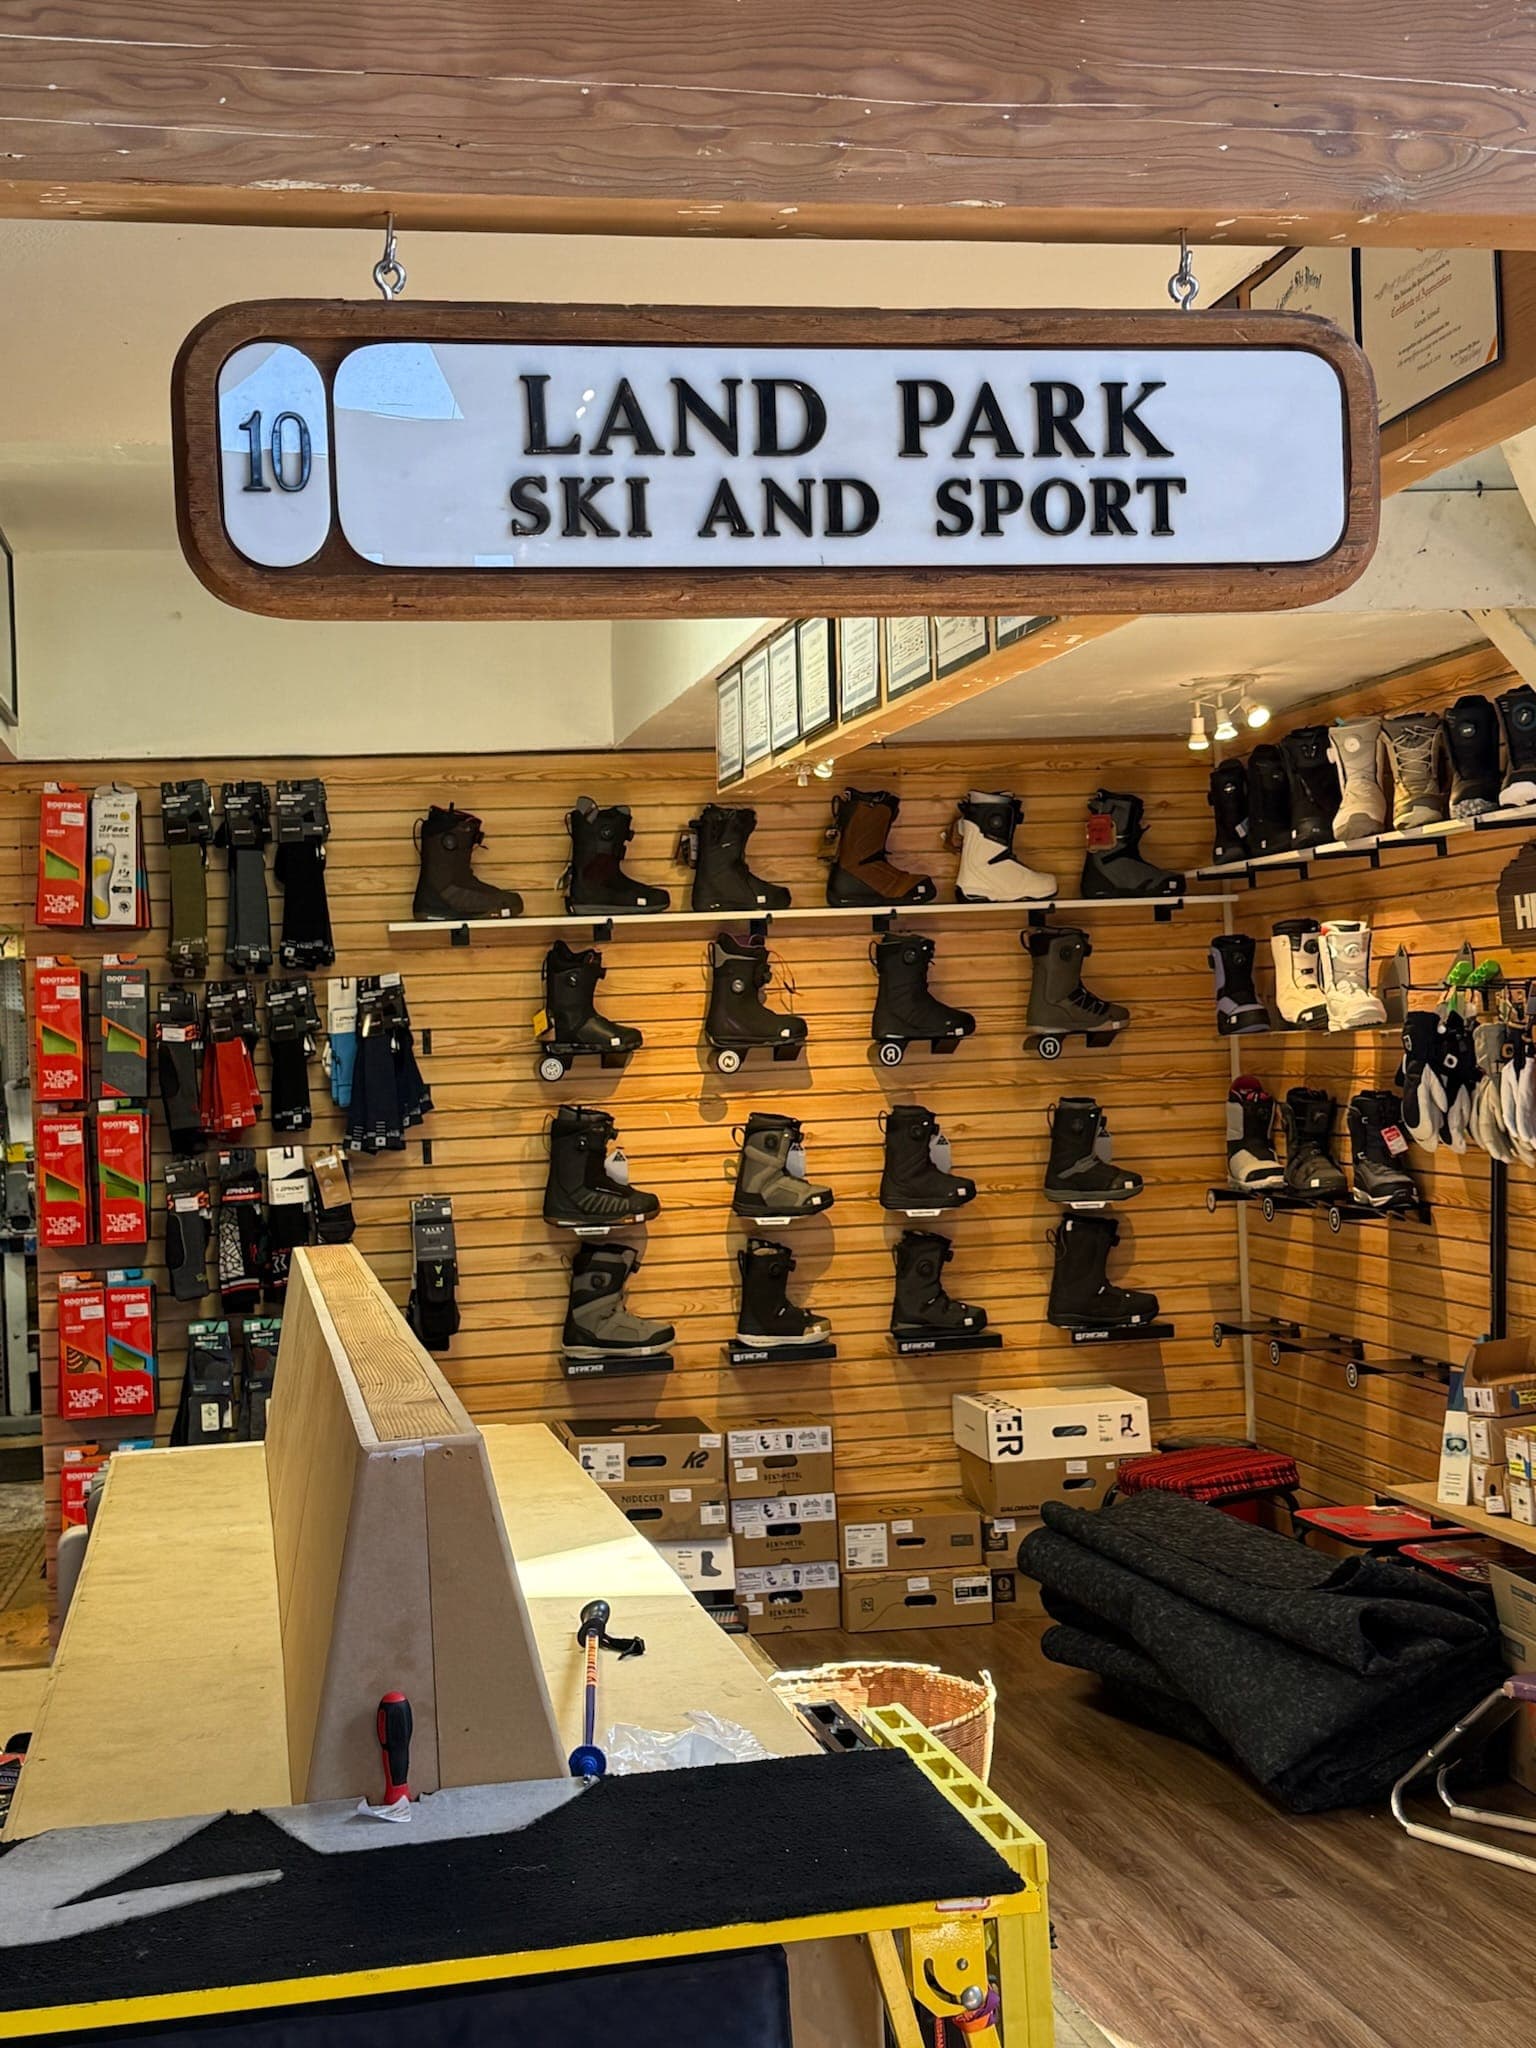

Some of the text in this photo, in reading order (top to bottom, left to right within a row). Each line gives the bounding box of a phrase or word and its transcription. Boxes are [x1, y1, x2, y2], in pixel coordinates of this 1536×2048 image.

[519, 374, 1175, 458] LAND PARK
[238, 410, 312, 493] 10
[510, 475, 1187, 538] SKI AND SPORT
[44, 894, 75, 904] TUNE
[44, 906, 74, 914] FEET
[43, 1069, 74, 1079] TUNE
[43, 1081, 72, 1089] FEET
[46, 1216, 77, 1225] TUNE
[106, 1213, 137, 1222] TUNE
[46, 1228, 75, 1236] FEET
[107, 1225, 135, 1233] FEET
[68, 1388, 99, 1397] TUNE
[114, 1384, 145, 1394] TUNE
[68, 1400, 97, 1408] FEET
[114, 1397, 143, 1405] FEET
[681, 1450, 710, 1470] K2
[621, 1494, 665, 1504] NIDECKER
